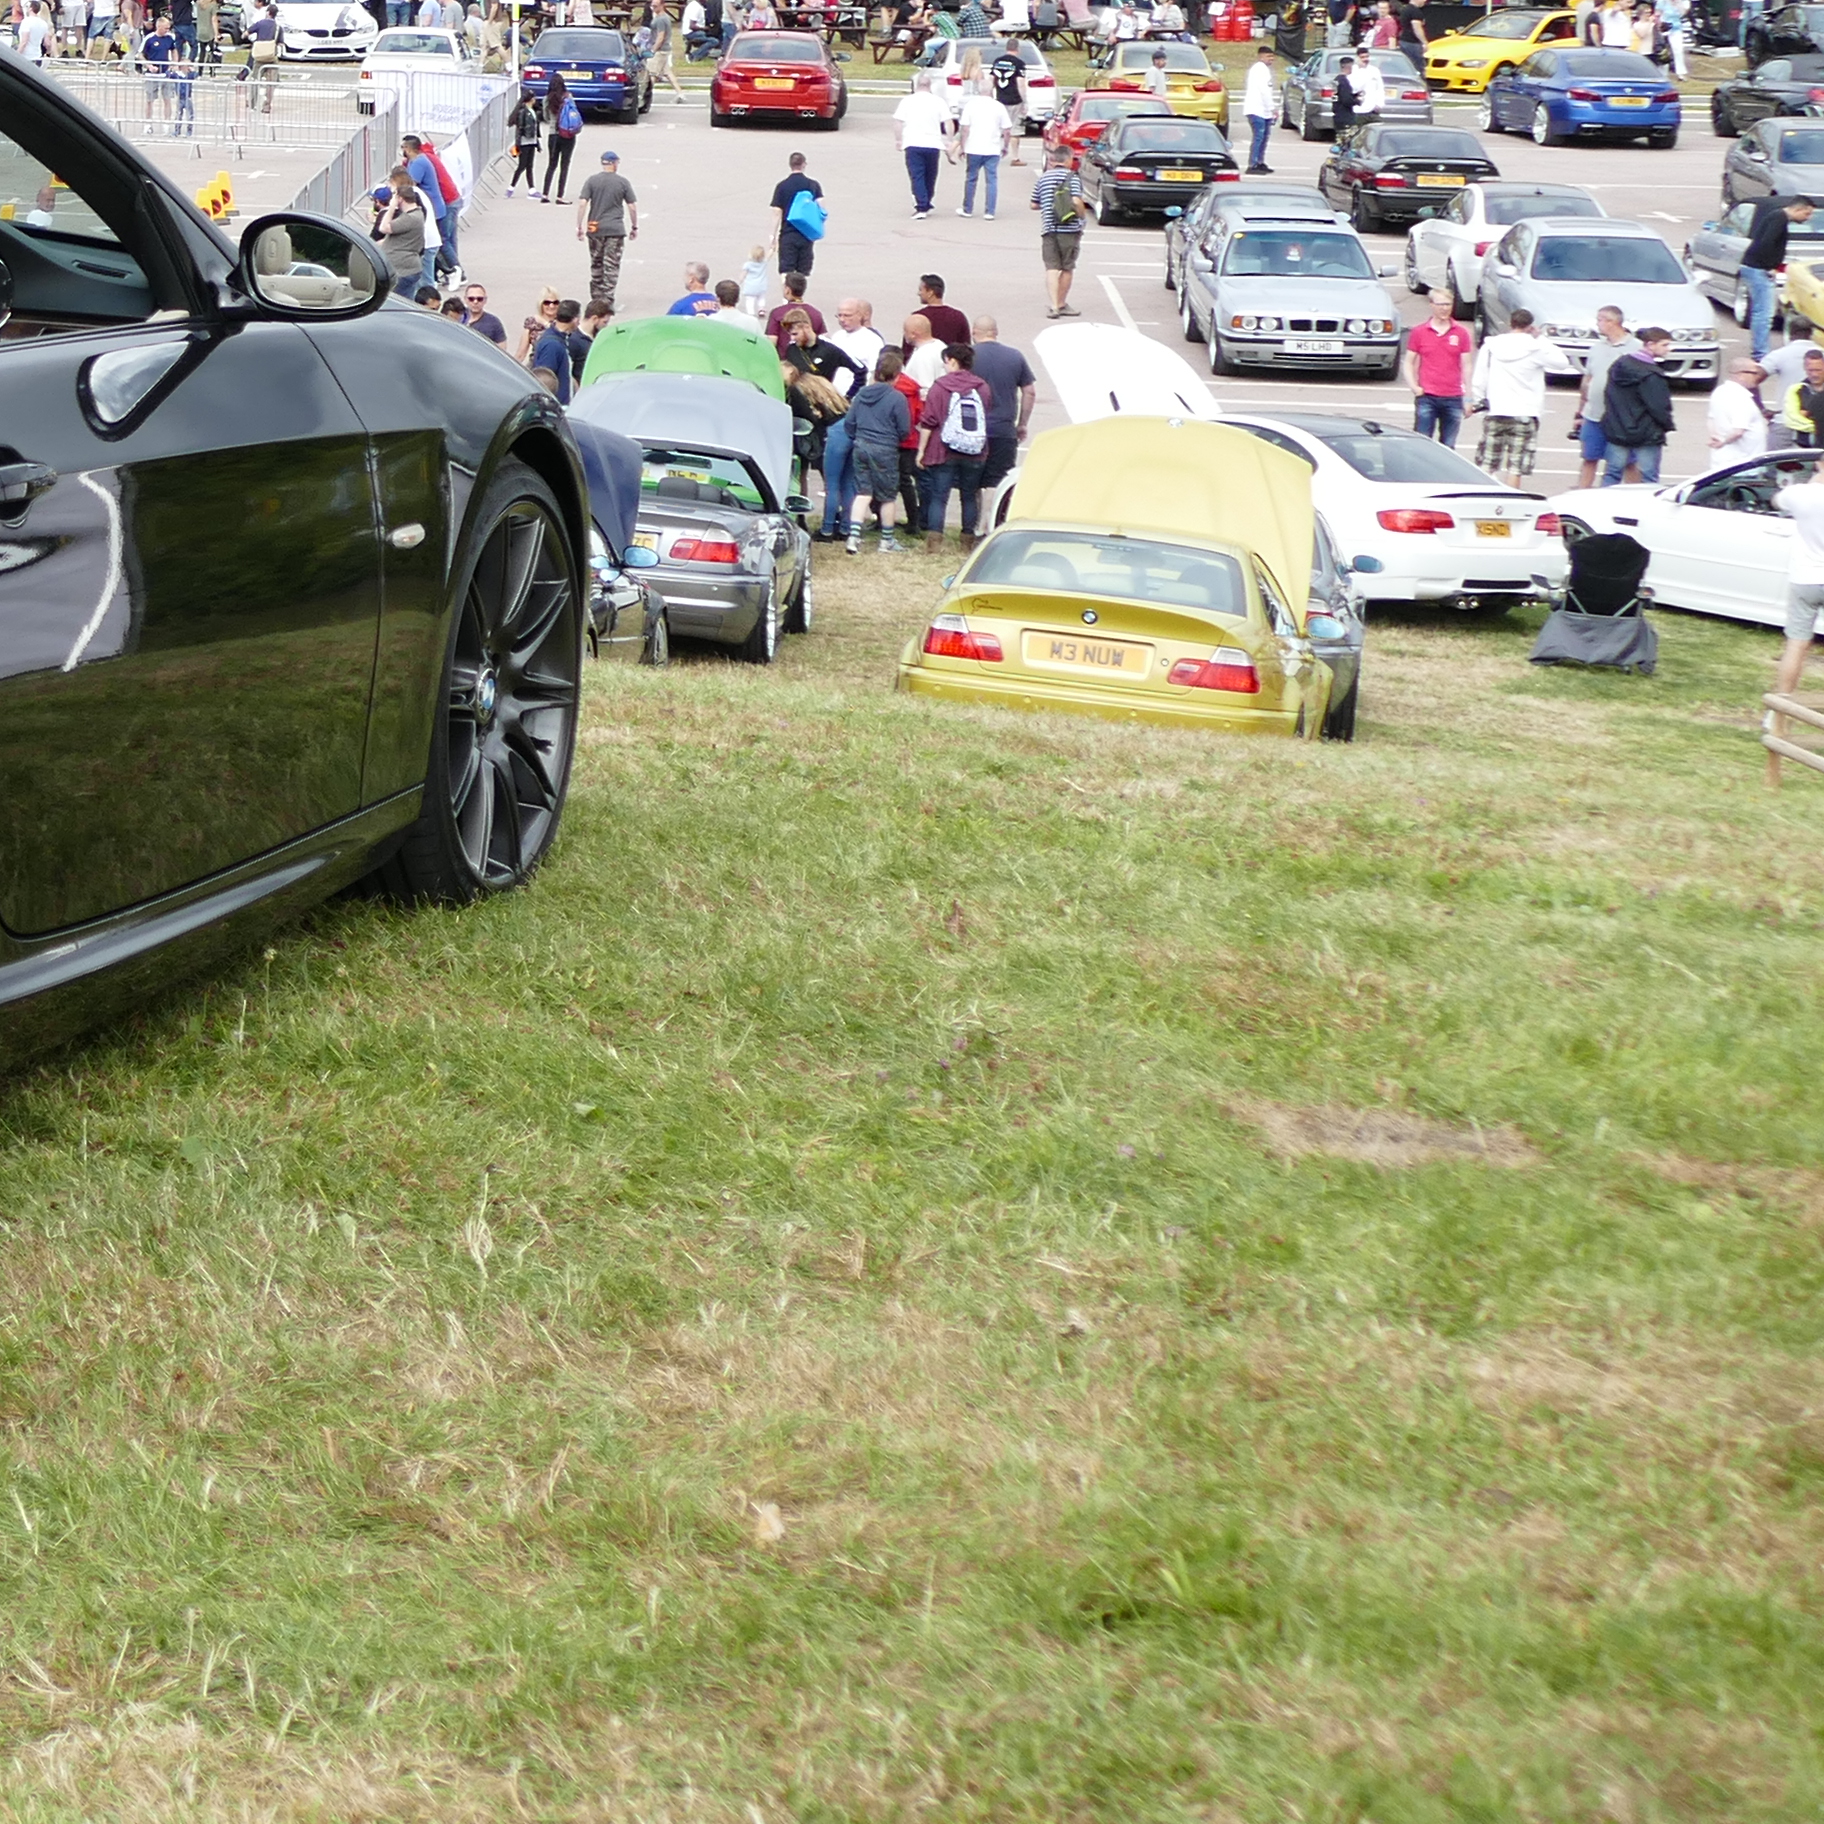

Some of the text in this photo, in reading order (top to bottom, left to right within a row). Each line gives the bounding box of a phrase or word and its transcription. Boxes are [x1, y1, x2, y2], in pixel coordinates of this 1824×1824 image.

[1296, 342, 1332, 351] M5 LHD
[1049, 640, 1125, 667] M3 NUW
